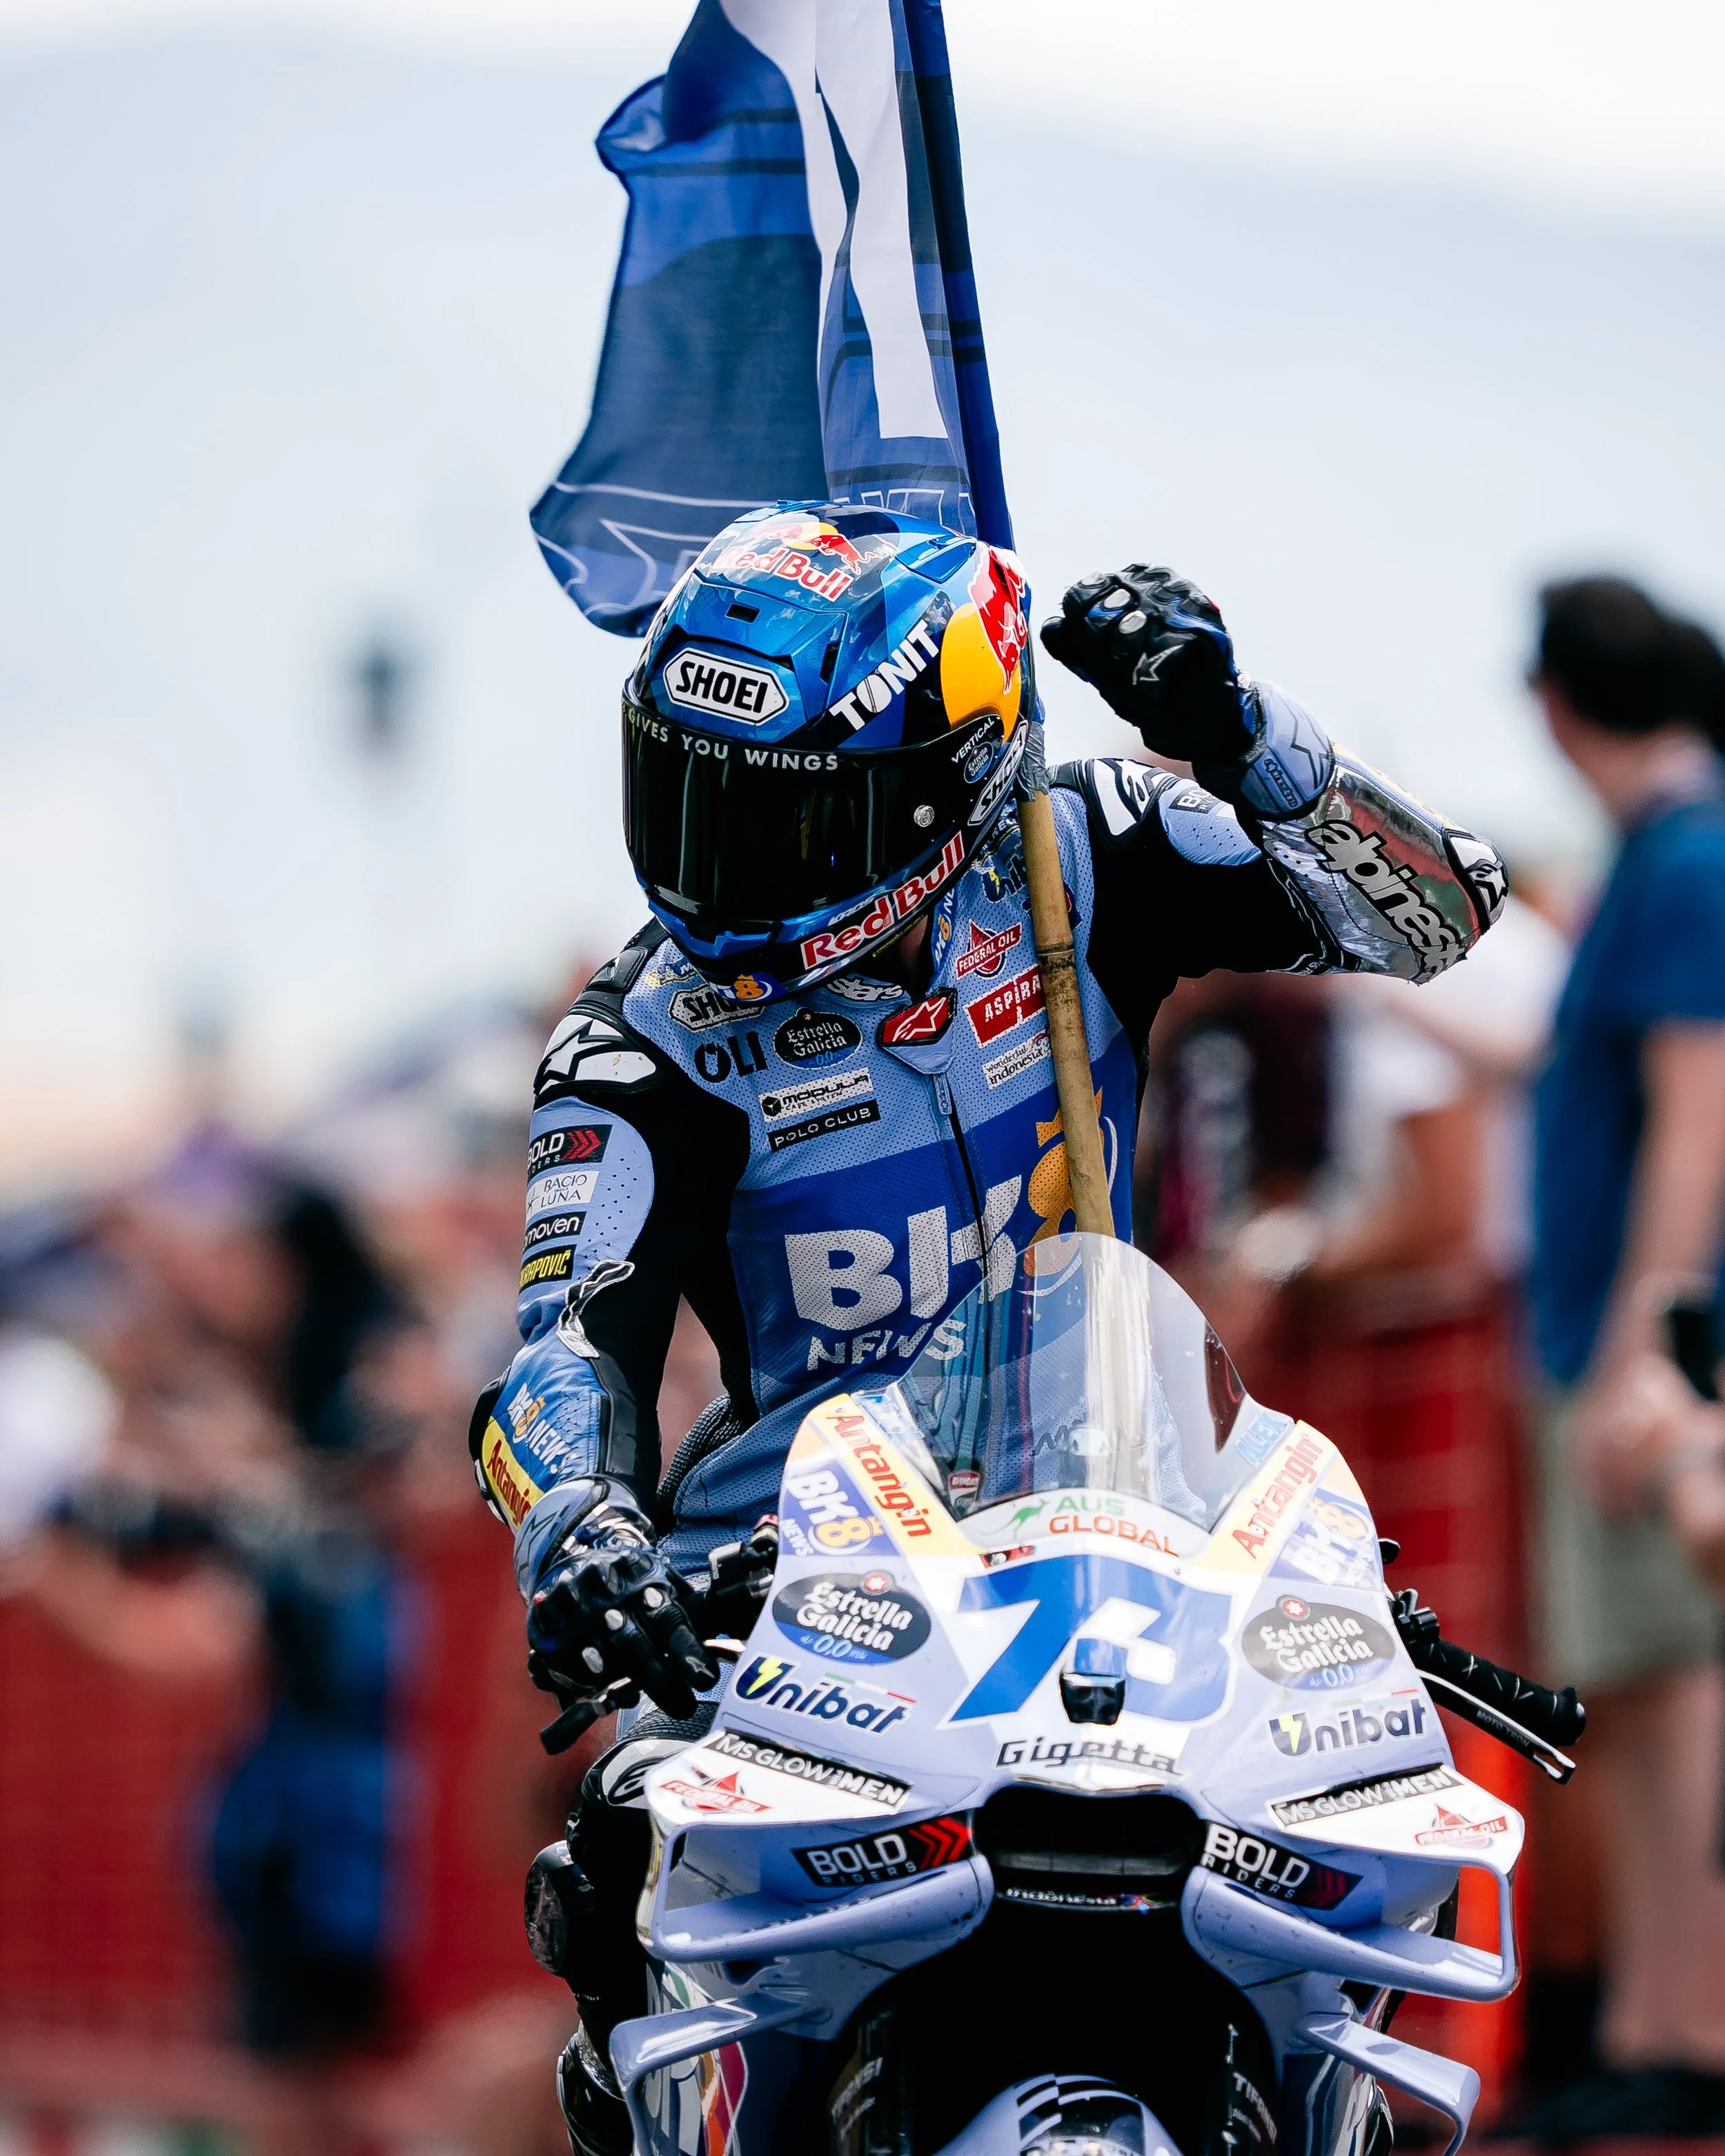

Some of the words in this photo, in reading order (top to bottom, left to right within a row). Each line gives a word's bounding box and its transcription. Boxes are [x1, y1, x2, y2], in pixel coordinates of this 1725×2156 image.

[773, 552, 853, 602] Bull
[676, 660, 769, 713] SHOEI
[829, 620, 939, 731] TONIT
[627, 706, 669, 743] GIVES
[681, 733, 729, 760] YOU
[745, 748, 838, 771] WINGS
[951, 717, 995, 764] VERTICAL
[802, 895, 895, 969] Red
[894, 831, 965, 919] Bull
[958, 942, 996, 973] FEDERAL
[998, 931, 1016, 949] OIL
[985, 974, 1041, 1022] ASPIRA
[787, 1022, 843, 1045] Estrella
[793, 1034, 847, 1056] Galicia
[773, 1123, 819, 1147] POLO
[825, 1107, 871, 1127] CLUB
[527, 1133, 565, 1171] BOLD
[531, 1154, 561, 1174] DERS
[540, 1189, 581, 1208] LUNA
[825, 1414, 933, 1538] Antangin
[1232, 1436, 1324, 1560] Antangin
[788, 1470, 884, 1554] BK8
[1054, 1494, 1125, 1516] AUS
[1048, 1514, 1180, 1559] GLOBAL
[796, 1602, 895, 1652] Galicia
[804, 1581, 914, 1630] Estrella
[1259, 1615, 1364, 1650] Estrella
[1276, 1638, 1374, 1673] Galicia
[735, 1656, 909, 1733] Unibat
[1268, 1699, 1426, 1757] Unibat
[716, 1734, 757, 1759] MS
[757, 1748, 832, 1781] GLOW
[838, 1771, 904, 1806] MEN
[996, 1736, 1183, 1776] Gigetta
[1280, 1801, 1315, 1823] MS
[1314, 1785, 1385, 1815] GLOW
[1392, 1770, 1452, 1797] MEN
[807, 1833, 908, 1876] BOLD
[1201, 1852, 1296, 1899] RIDERS
[1205, 1823, 1310, 1888] BOLD
